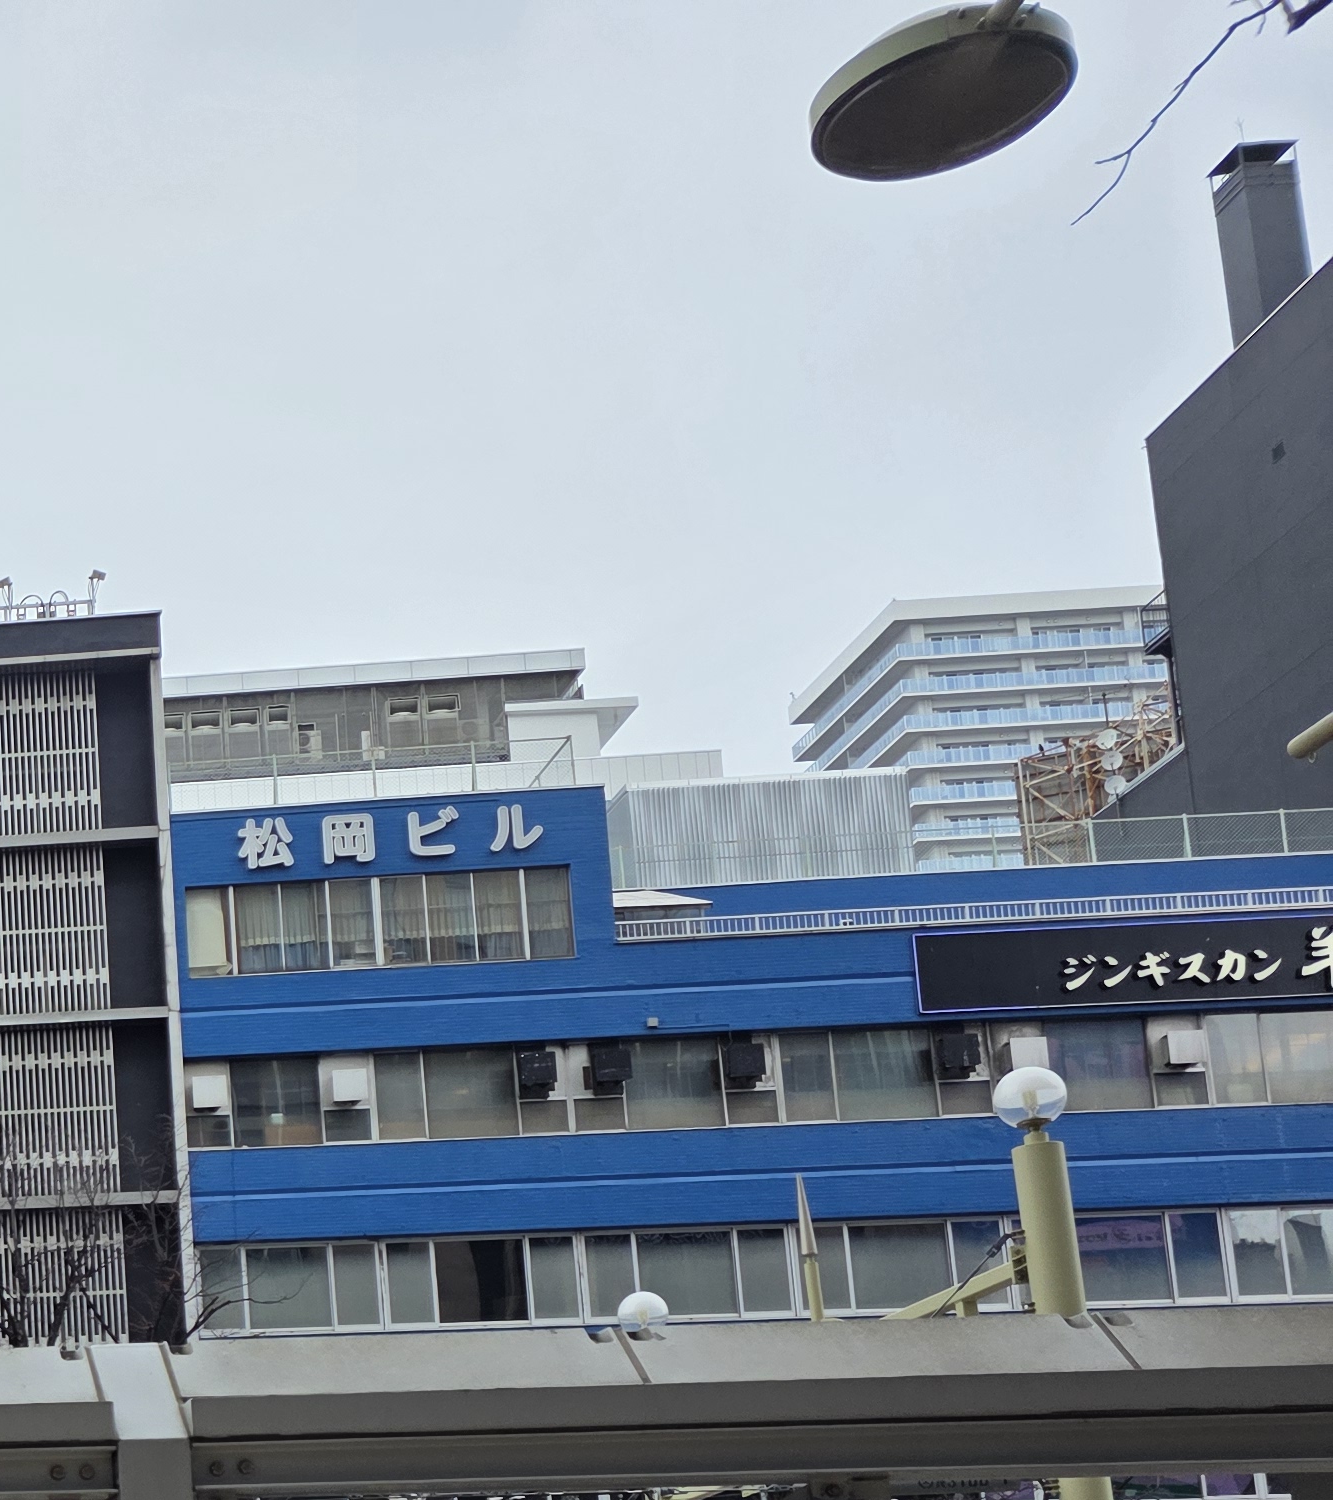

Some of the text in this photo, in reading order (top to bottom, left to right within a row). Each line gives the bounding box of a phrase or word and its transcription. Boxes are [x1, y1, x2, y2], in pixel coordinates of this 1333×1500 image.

[237, 804, 544, 869] 松岡ビル
[1061, 949, 1282, 991] ジンギスカン
